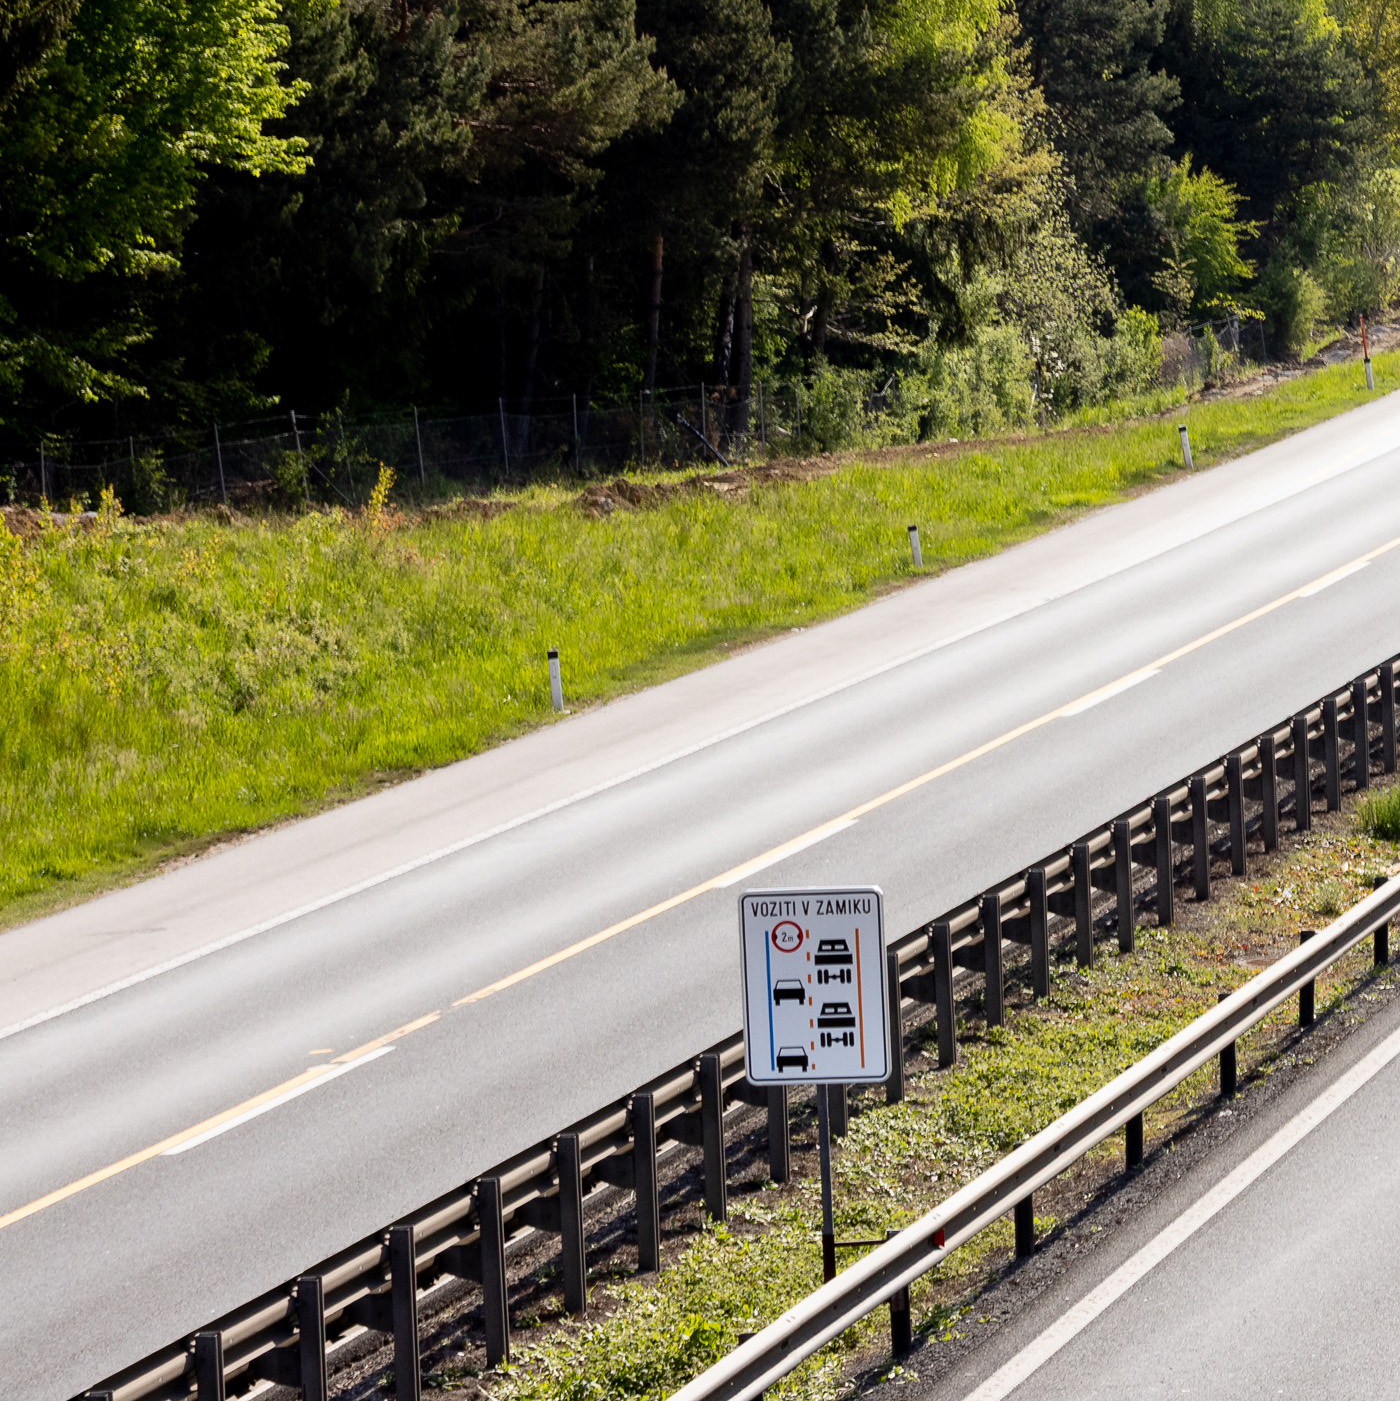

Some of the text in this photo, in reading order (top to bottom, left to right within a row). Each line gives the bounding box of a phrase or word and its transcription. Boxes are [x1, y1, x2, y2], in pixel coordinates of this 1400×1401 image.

[751, 899, 871, 917] VOZITI V ZAMIKU
